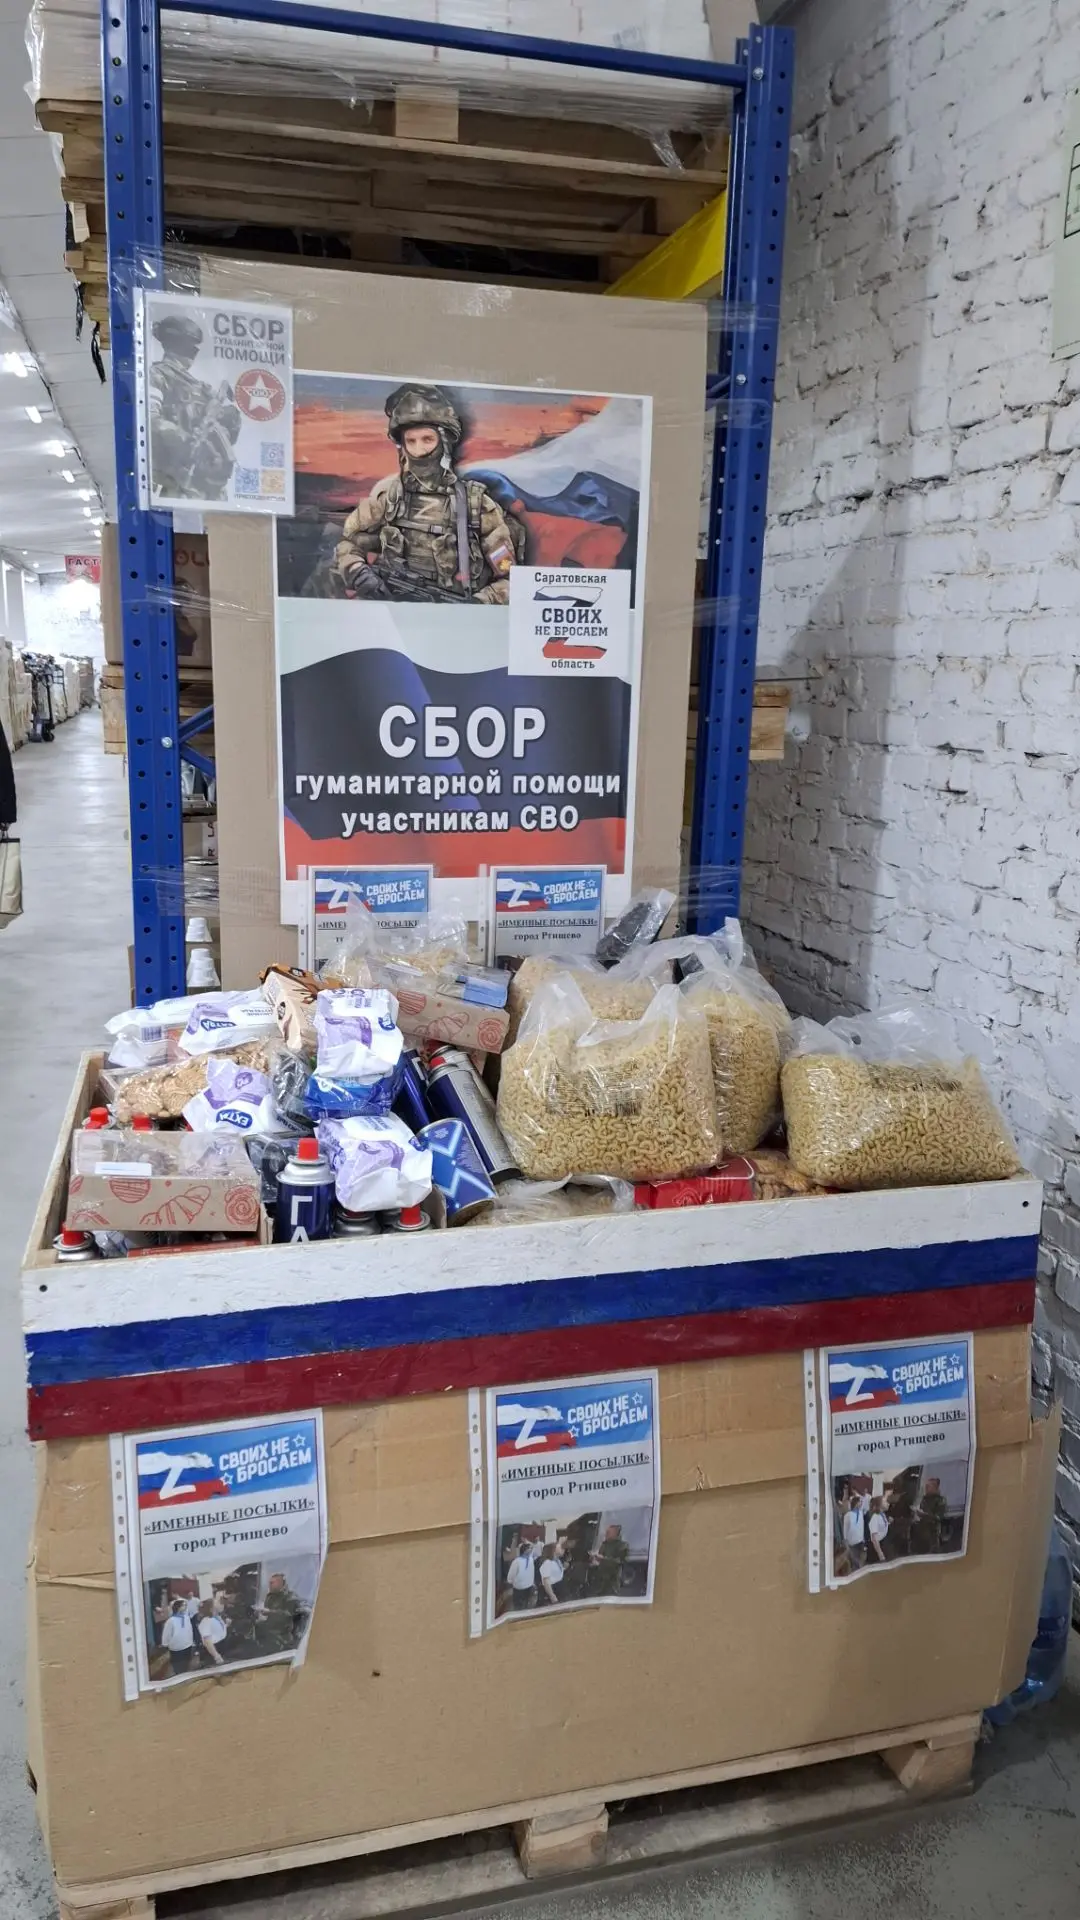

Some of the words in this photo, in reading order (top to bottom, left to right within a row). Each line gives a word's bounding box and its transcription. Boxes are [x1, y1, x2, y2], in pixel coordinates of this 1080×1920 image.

[213, 313, 285, 341] СБОР
[213, 346, 285, 366] ПОМОЩИ
[67, 558, 100, 566] ГАСТ
[534, 572, 607, 584] Саратовская
[542, 608, 602, 624] СВОИХ
[535, 626, 551, 636] НЕ
[554, 626, 608, 637] БРОСАЕМ
[551, 659, 596, 669] область
[379, 705, 547, 759] СБОР
[295, 769, 501, 801] гуманитарной
[513, 774, 622, 797] помощи
[342, 811, 509, 838] участникам
[520, 805, 580, 831] СВО
[366, 883, 399, 897] СВОИХ
[400, 880, 412, 891] НЕ
[377, 889, 425, 905] БРОСАЕМ
[544, 881, 574, 896] СВОИХ
[575, 880, 586, 890] НЕ
[554, 888, 599, 904] БРОСАЕМ
[513, 932, 539, 942] город
[542, 931, 582, 941] Ртищево
[892, 1358, 931, 1382] СВОИХ
[933, 1355, 948, 1370] НЕ
[905, 1365, 964, 1394] БРОСАЕМ
[567, 1399, 611, 1424] СВОИХ
[613, 1395, 629, 1412] НЕ
[582, 1405, 648, 1436] БРОСАЕМ
[834, 1416, 900, 1434] «ИМЕННЫЕ
[903, 1409, 966, 1427] ПОСЫЛКИ»
[219, 1442, 268, 1471] СВОИХ
[271, 1436, 290, 1456] НЕ
[857, 1440, 890, 1454] город
[894, 1432, 946, 1448] Ртищево
[236, 1448, 312, 1483] БРОСАЕМ
[501, 1461, 575, 1480] «ИМЕННЫЕ
[578, 1452, 650, 1471] ПОСЫЛКИ»
[526, 1484, 564, 1500] город
[568, 1477, 627, 1494] Ртищево
[144, 1510, 229, 1532] «ИМЕННЫЕ
[233, 1498, 315, 1520] ПОСЫЛКИ»
[173, 1535, 216, 1553] город
[221, 1526, 289, 1545] Ртищево
